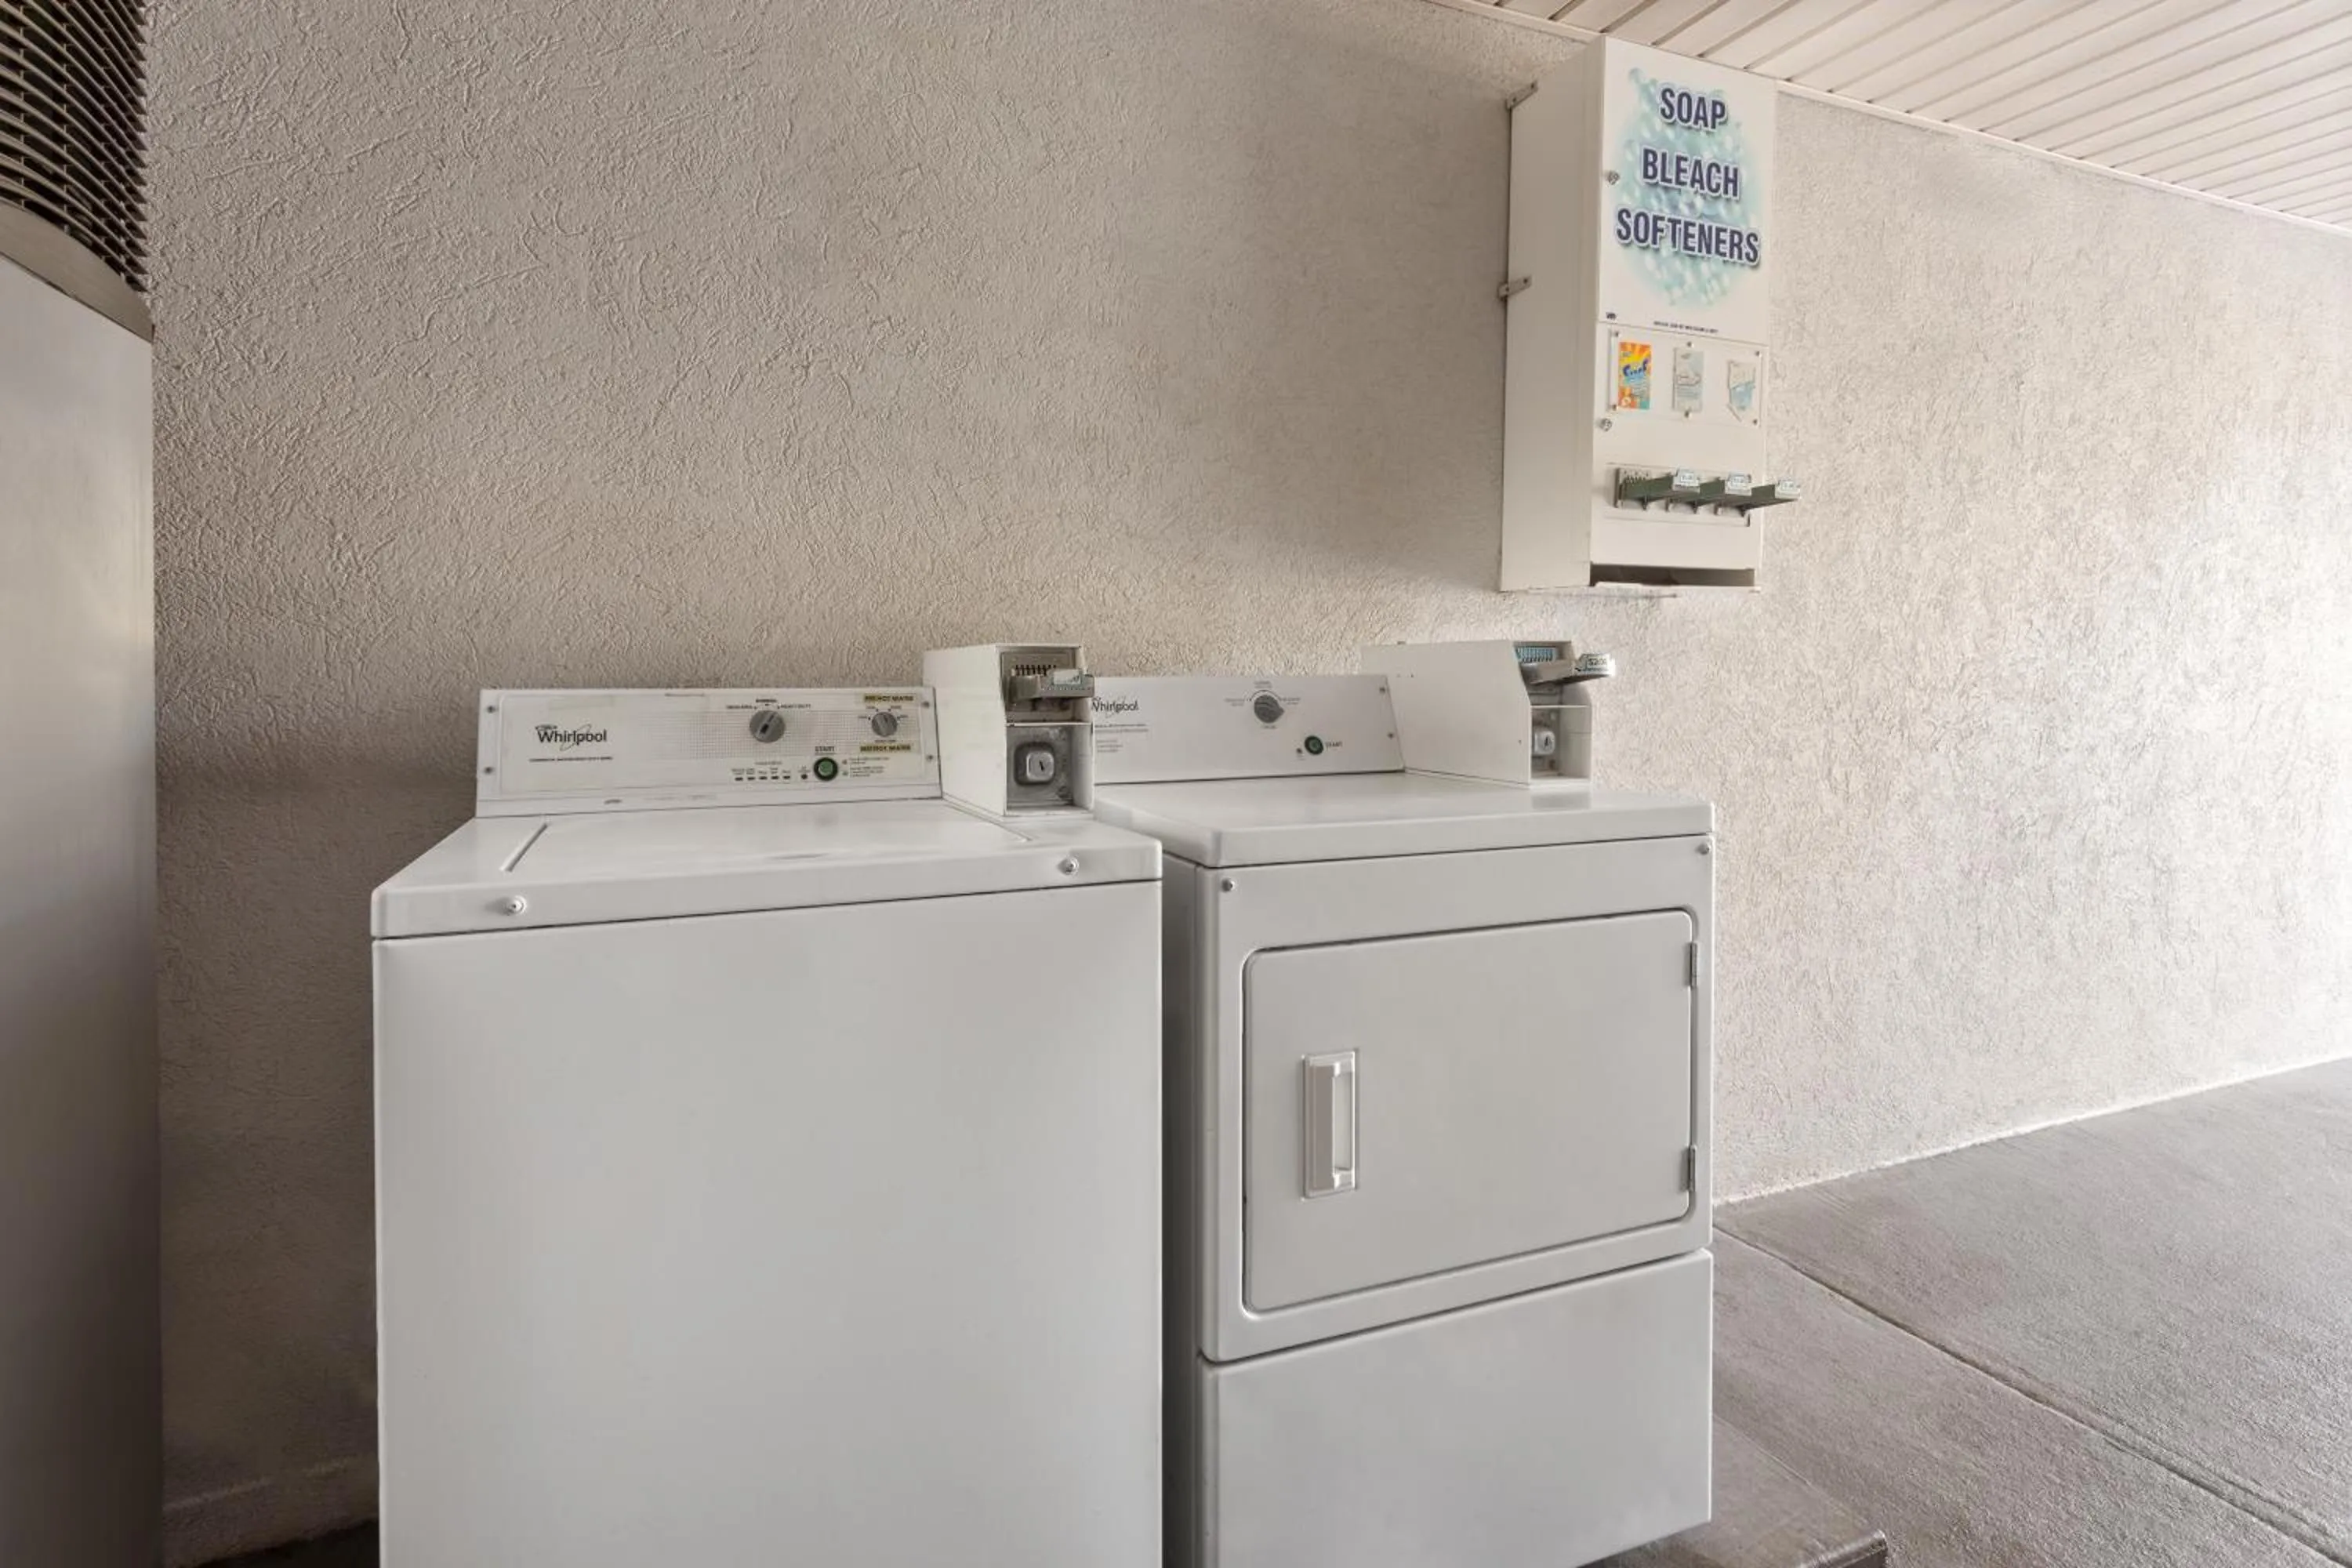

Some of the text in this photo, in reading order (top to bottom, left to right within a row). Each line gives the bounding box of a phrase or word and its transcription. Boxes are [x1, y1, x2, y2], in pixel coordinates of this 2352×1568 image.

[1659, 86, 1726, 130] SOAP
[1642, 147, 1739, 198] BLEACH
[1616, 207, 1759, 263] SOFTENERS
[537, 729, 607, 745] Whirlpool
